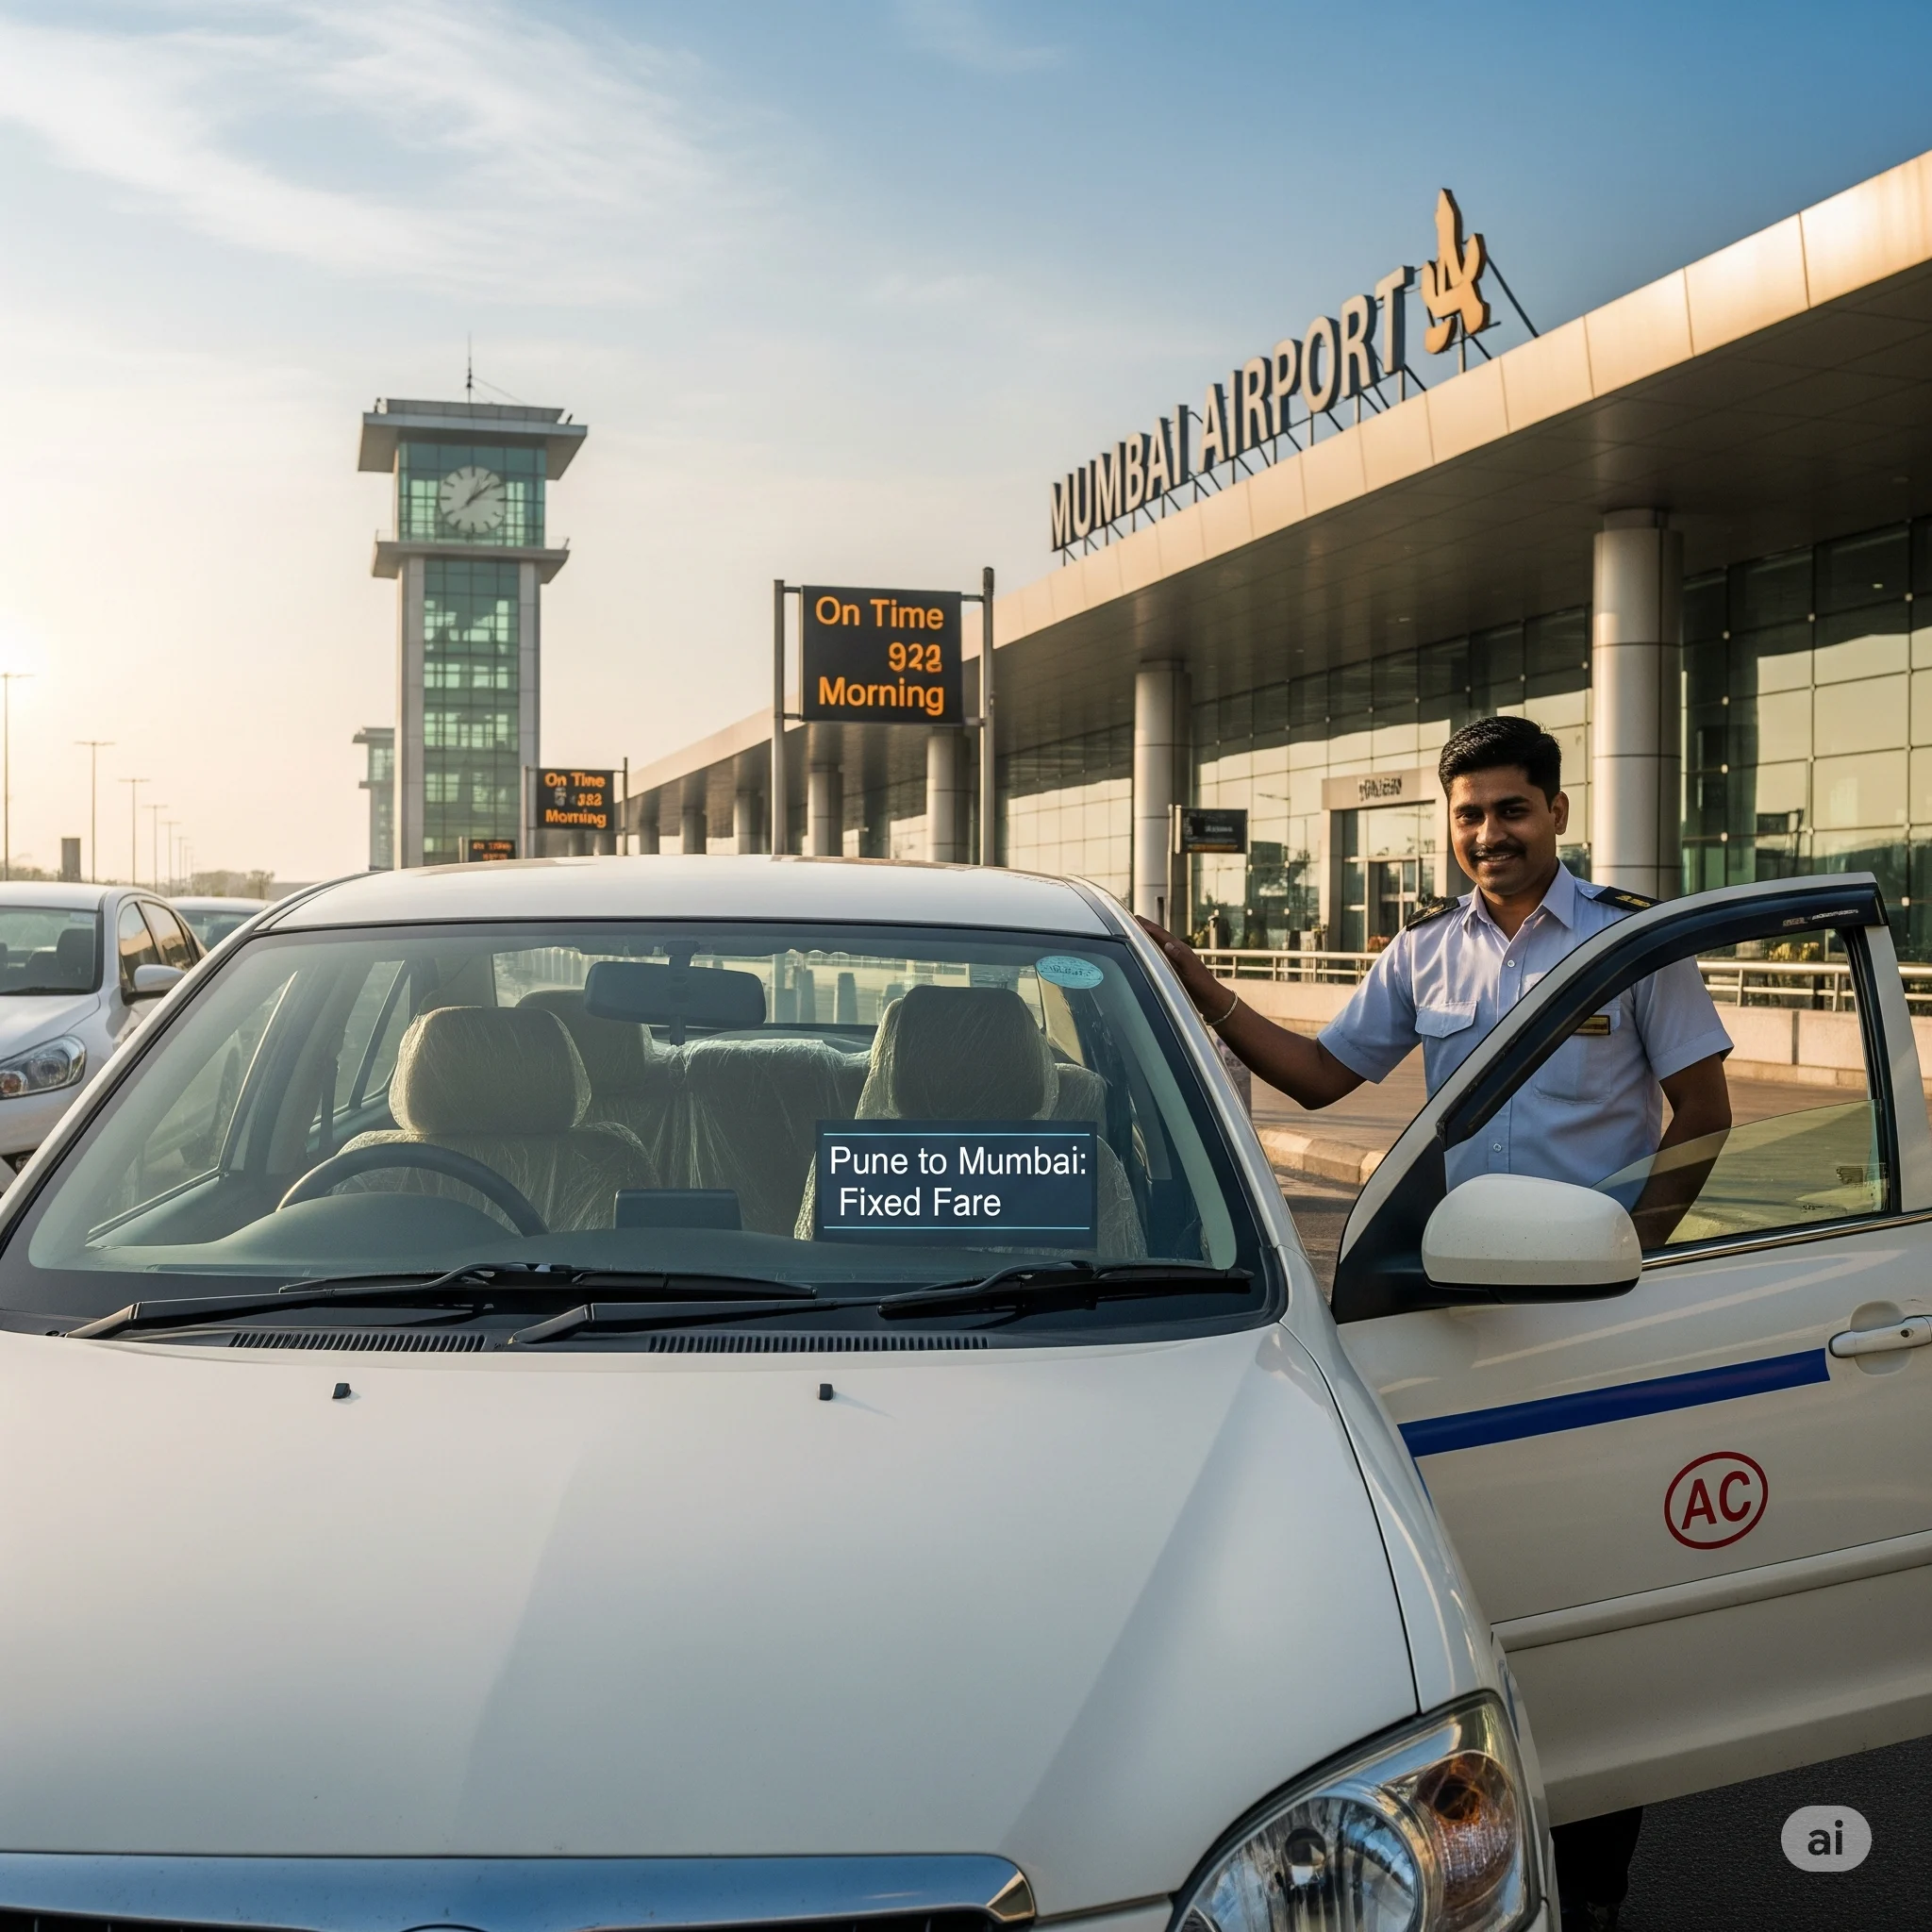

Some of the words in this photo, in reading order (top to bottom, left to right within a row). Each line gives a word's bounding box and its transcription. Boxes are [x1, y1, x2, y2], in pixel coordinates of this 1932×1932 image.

[1051, 404, 1189, 551] MUMBAI
[1197, 265, 1415, 474] AIRPORT
[815, 595, 860, 626] On
[870, 598, 944, 630] Time
[819, 676, 944, 717] Morning
[544, 772, 567, 788] On
[830, 1145, 908, 1175] Pune
[918, 1147, 947, 1175] to
[959, 1145, 1086, 1175] Mumbai:
[840, 1187, 921, 1217] Fixed
[934, 1187, 1002, 1217] Fare
[1681, 1470, 1752, 1530] AC
